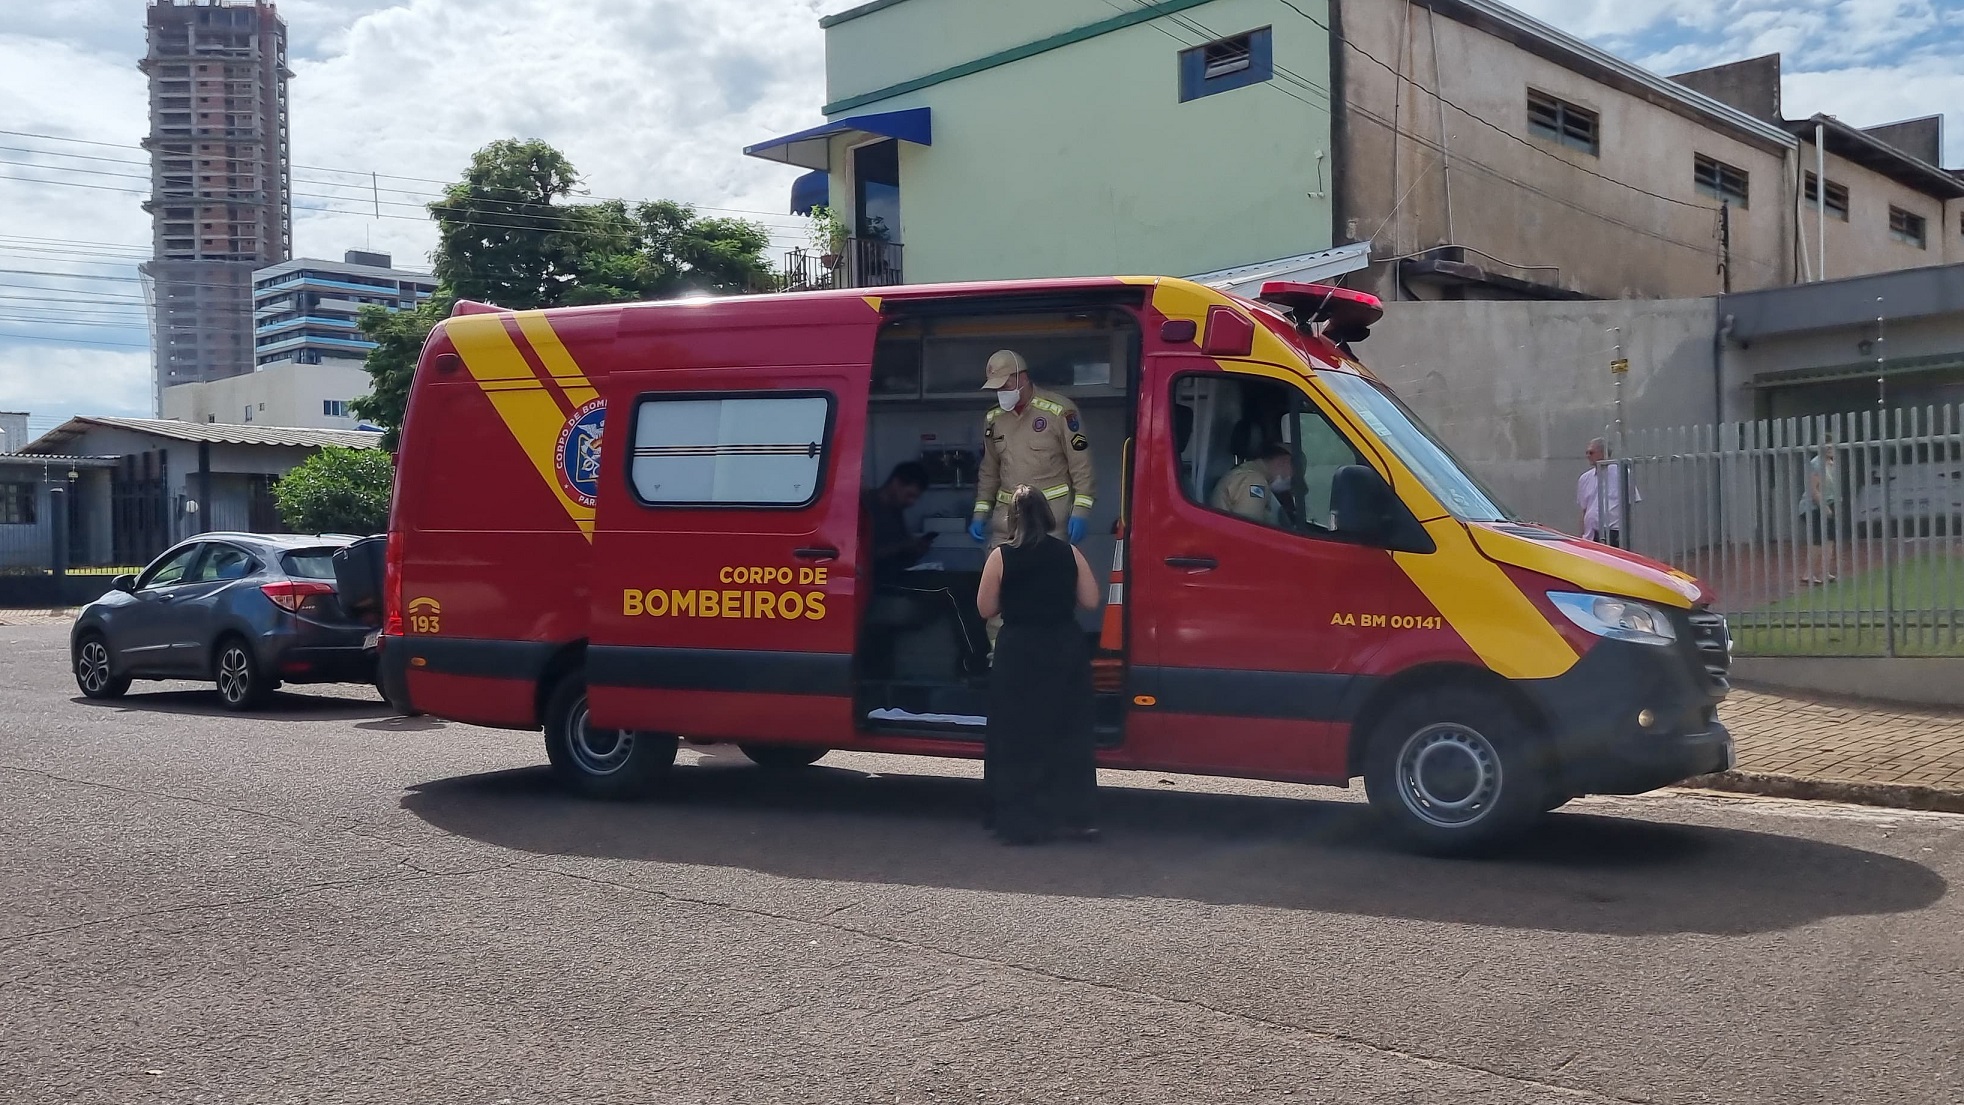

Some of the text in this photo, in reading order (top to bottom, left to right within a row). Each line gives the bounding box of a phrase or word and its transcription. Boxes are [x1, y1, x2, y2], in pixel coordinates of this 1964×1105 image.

[556, 399, 607, 469] CORPO DE BOM
[578, 495, 597, 506] PAR
[719, 566, 827, 585] CORPO DE
[623, 588, 826, 620] BOMBEIROS
[410, 615, 440, 633] 193
[1330, 612, 1441, 630] AA BM 00141
